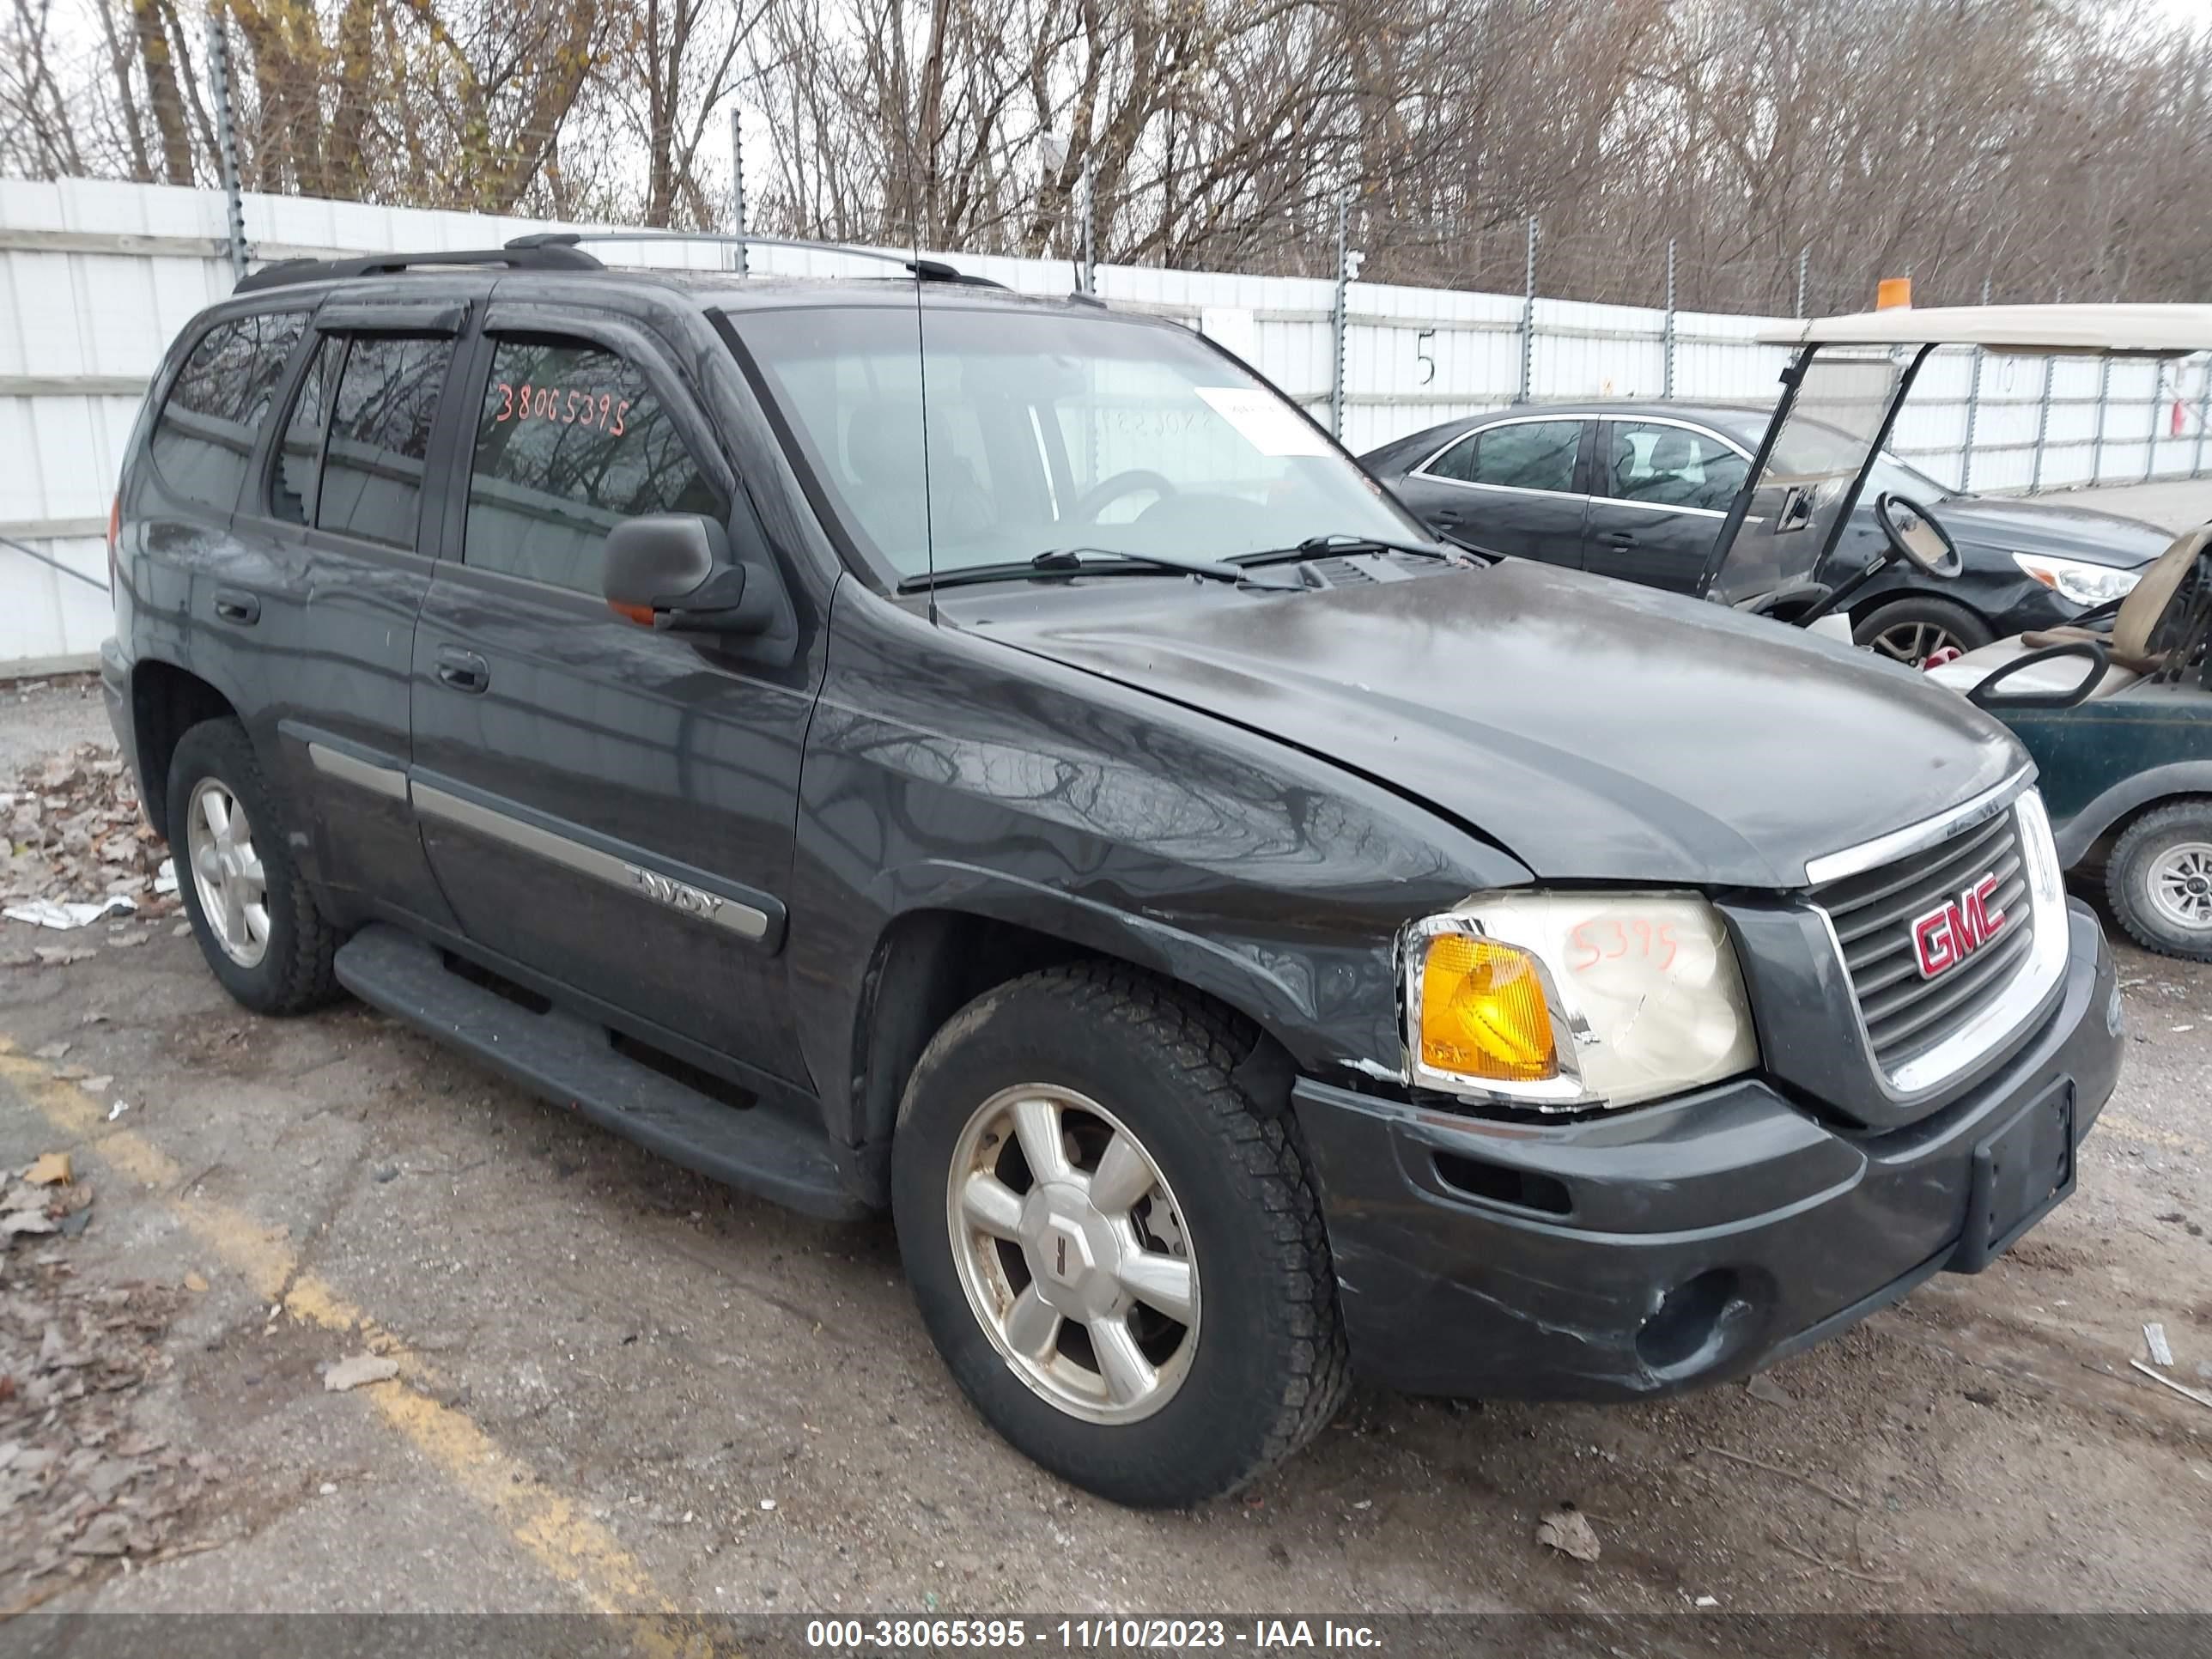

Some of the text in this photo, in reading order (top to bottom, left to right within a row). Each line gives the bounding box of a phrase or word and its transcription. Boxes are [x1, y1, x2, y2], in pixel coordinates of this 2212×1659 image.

[1417, 329, 1435, 385] 5
[496, 384, 629, 436] 38065395
[1571, 919, 1676, 972] 5395
[1911, 872, 2007, 980] GMC
